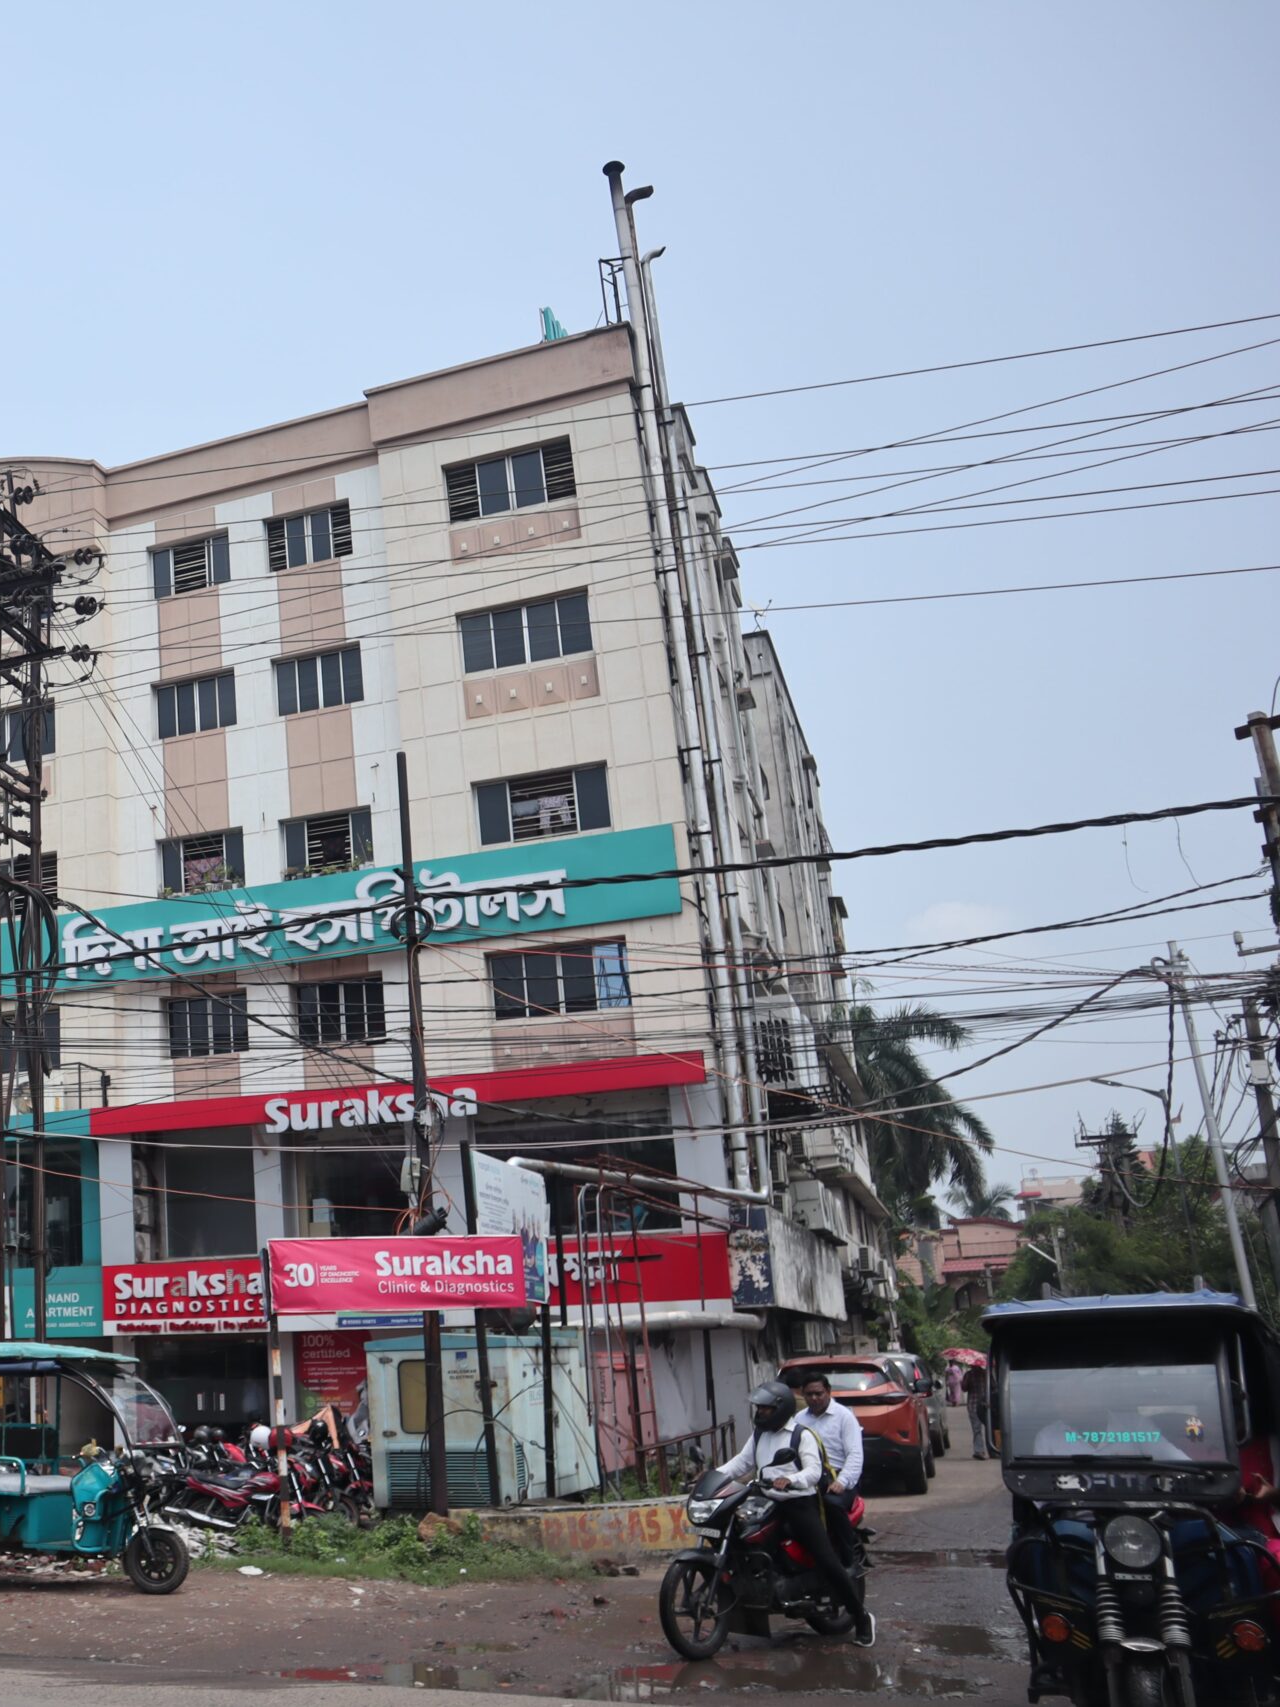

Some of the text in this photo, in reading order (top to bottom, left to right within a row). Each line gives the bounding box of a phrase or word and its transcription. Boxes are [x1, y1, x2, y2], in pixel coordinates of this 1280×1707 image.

[170, 902, 272, 965] আই
[283, 1263, 315, 1288] 30
[374, 1250, 513, 1277] Suraksha
[114, 1269, 263, 1300] Suraksha
[378, 1280, 514, 1295] Clinic & Diagnostics
[45, 1292, 80, 1304] NAND
[115, 1299, 265, 1315] DIAGNOSTICS
[302, 1335, 335, 1347] 100%
[302, 1348, 351, 1359] certified
